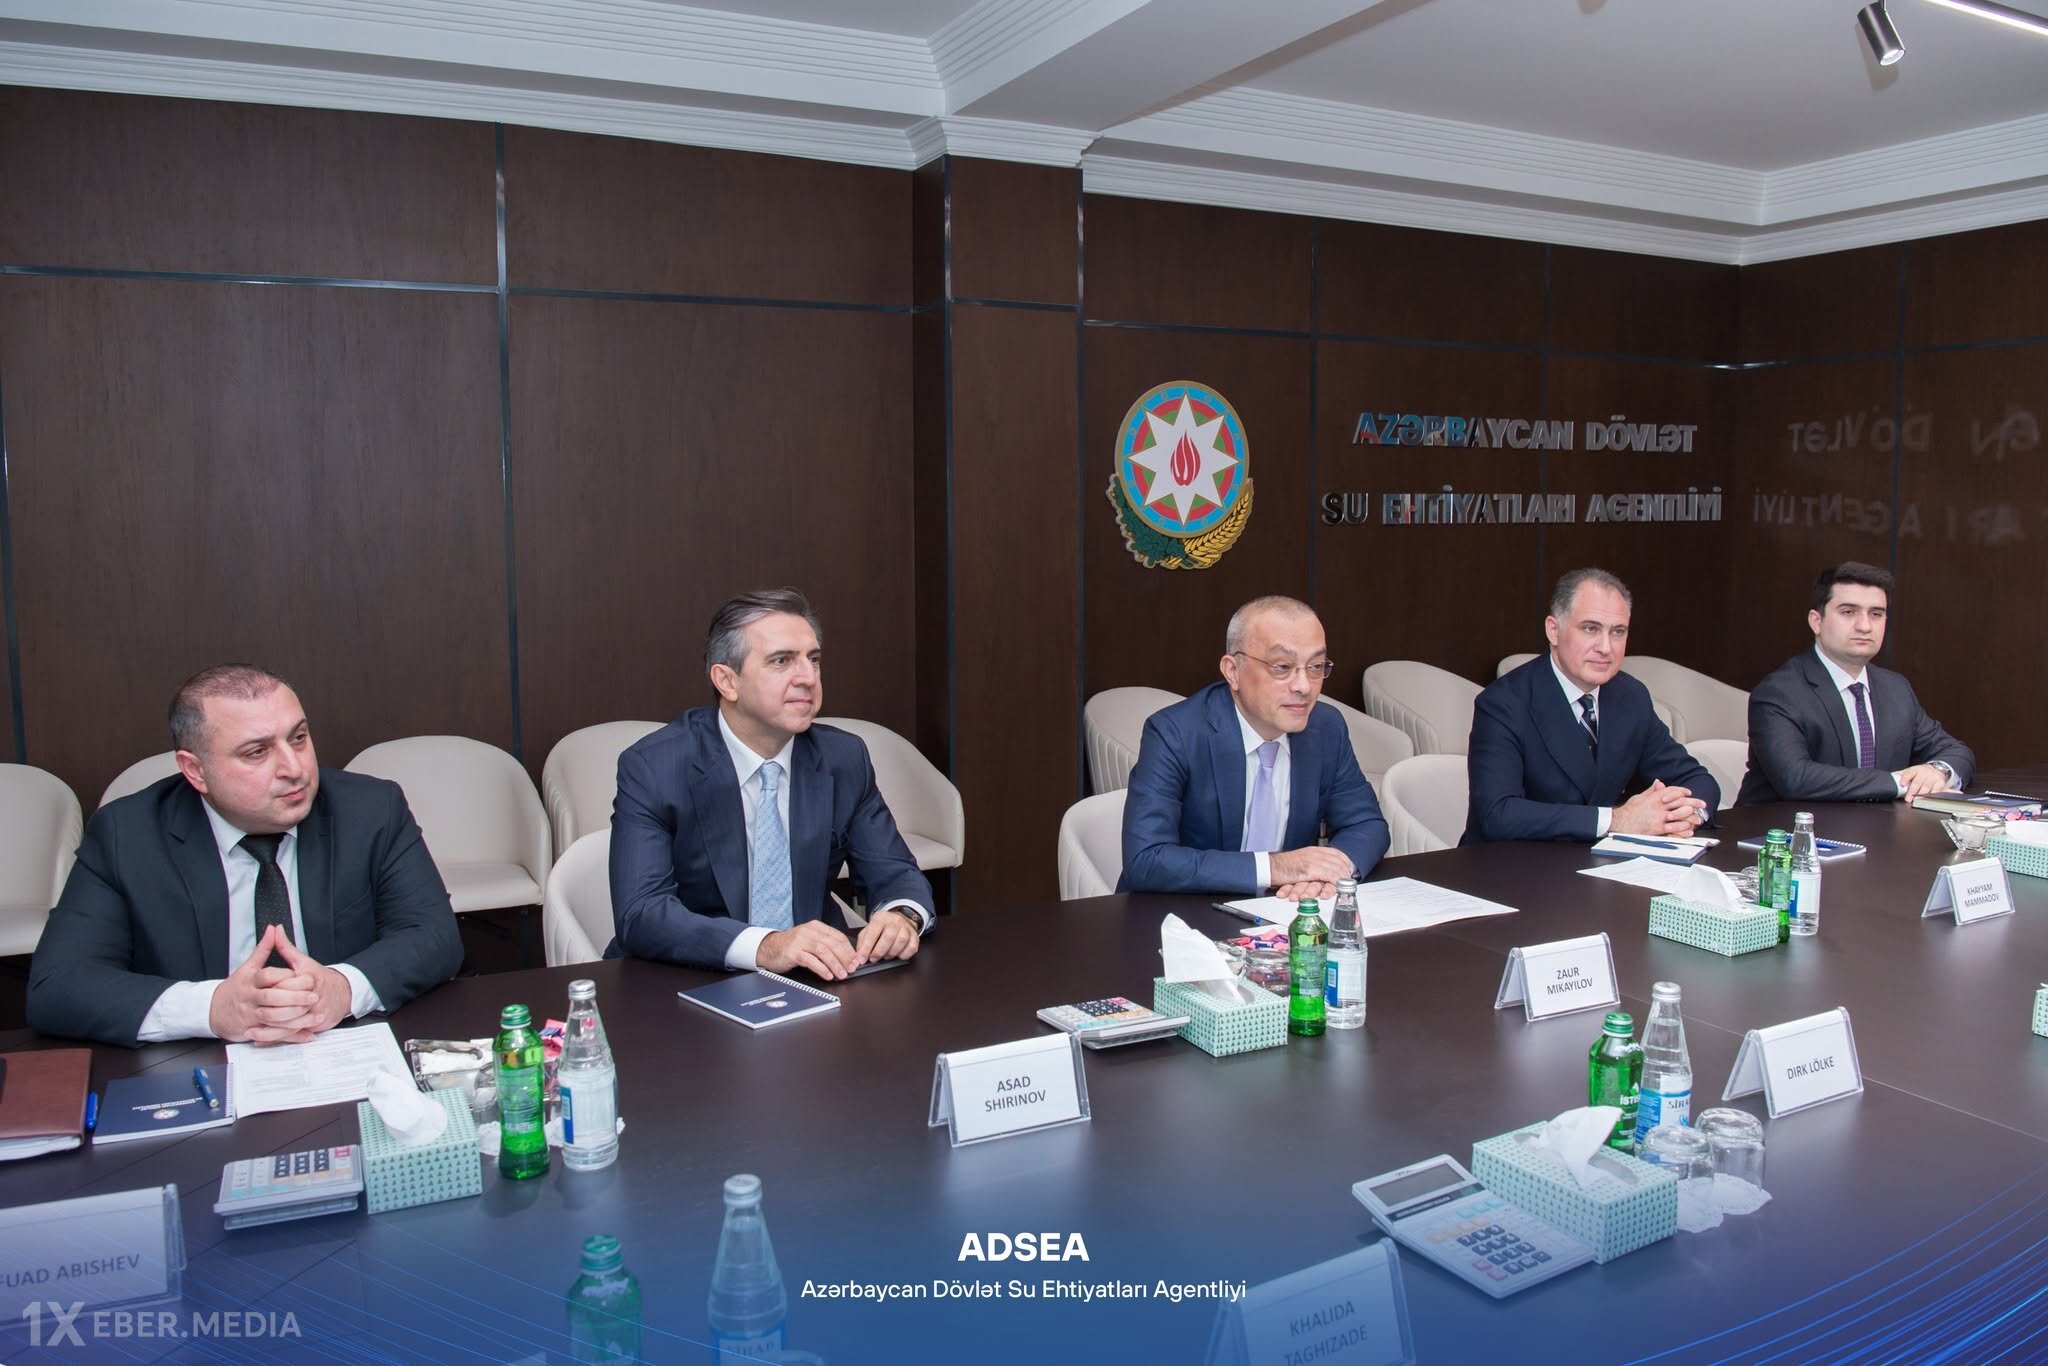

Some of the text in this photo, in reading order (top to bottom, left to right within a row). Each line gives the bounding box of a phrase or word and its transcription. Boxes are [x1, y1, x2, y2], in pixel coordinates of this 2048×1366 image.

[1352, 412, 1698, 452] AZƏRBAYCAN DÖVLƏT
[1321, 484, 1722, 525] SU EHTİYATLARI AGENTLİYİ
[1556, 966, 1580, 980] ZAUR
[1546, 977, 1593, 995] MIKAYILOV
[1787, 1056, 1835, 1080] DIRK LÖLKE
[997, 1076, 1031, 1093] ASAD
[984, 1089, 1046, 1112] SHIRINOV
[56, 1253, 140, 1280] ABISHEV
[1290, 1301, 1356, 1336] KHALIDA
[1284, 1324, 1368, 1366] TAGHIZADE
